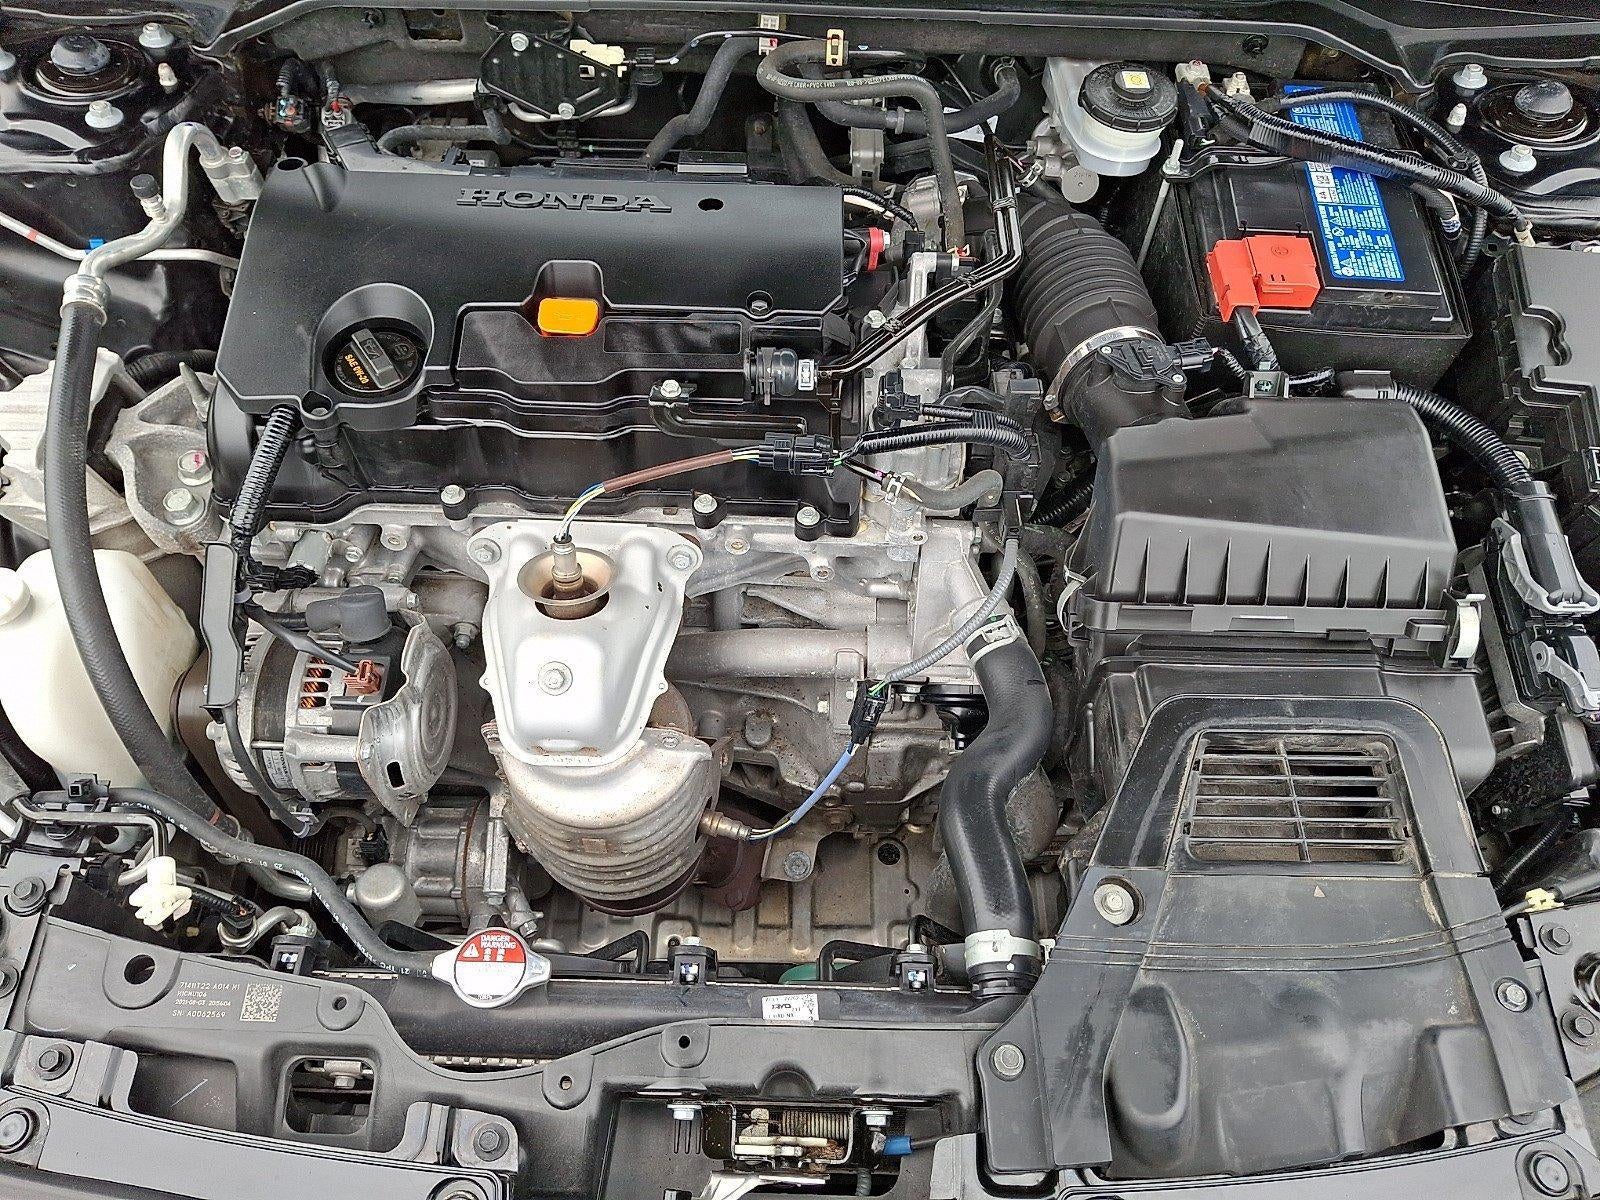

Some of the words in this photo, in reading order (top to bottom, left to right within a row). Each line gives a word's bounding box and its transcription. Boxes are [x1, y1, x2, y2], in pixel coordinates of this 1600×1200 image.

[457, 188, 672, 213] HONDA
[344, 353, 355, 368] SAE
[352, 365, 370, 384] 0W-20
[480, 941, 516, 949] WARNING
[379, 961, 396, 972] TPC
